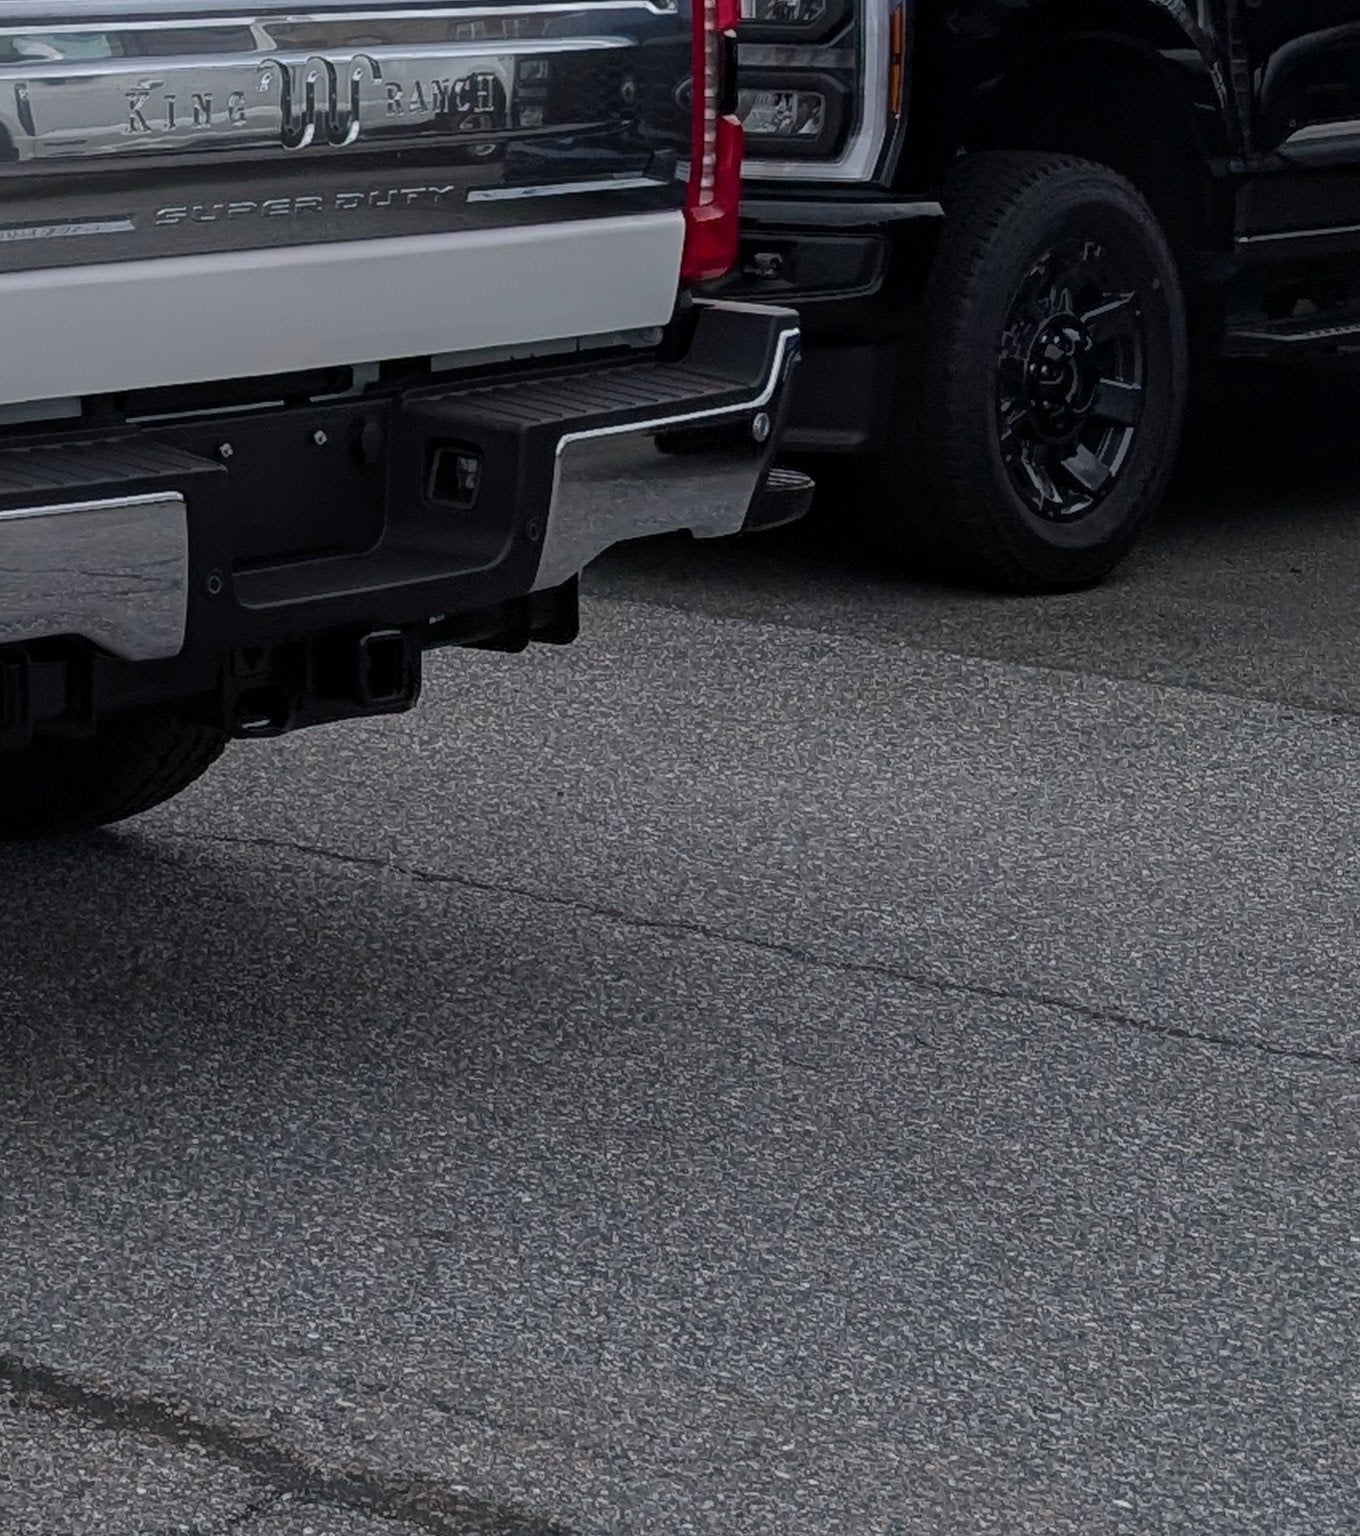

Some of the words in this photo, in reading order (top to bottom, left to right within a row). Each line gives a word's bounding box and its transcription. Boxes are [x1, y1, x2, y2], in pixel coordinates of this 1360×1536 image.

[385, 72, 496, 117] RANCH
[155, 195, 323, 226] SUPER
[336, 185, 455, 212] DUTY
